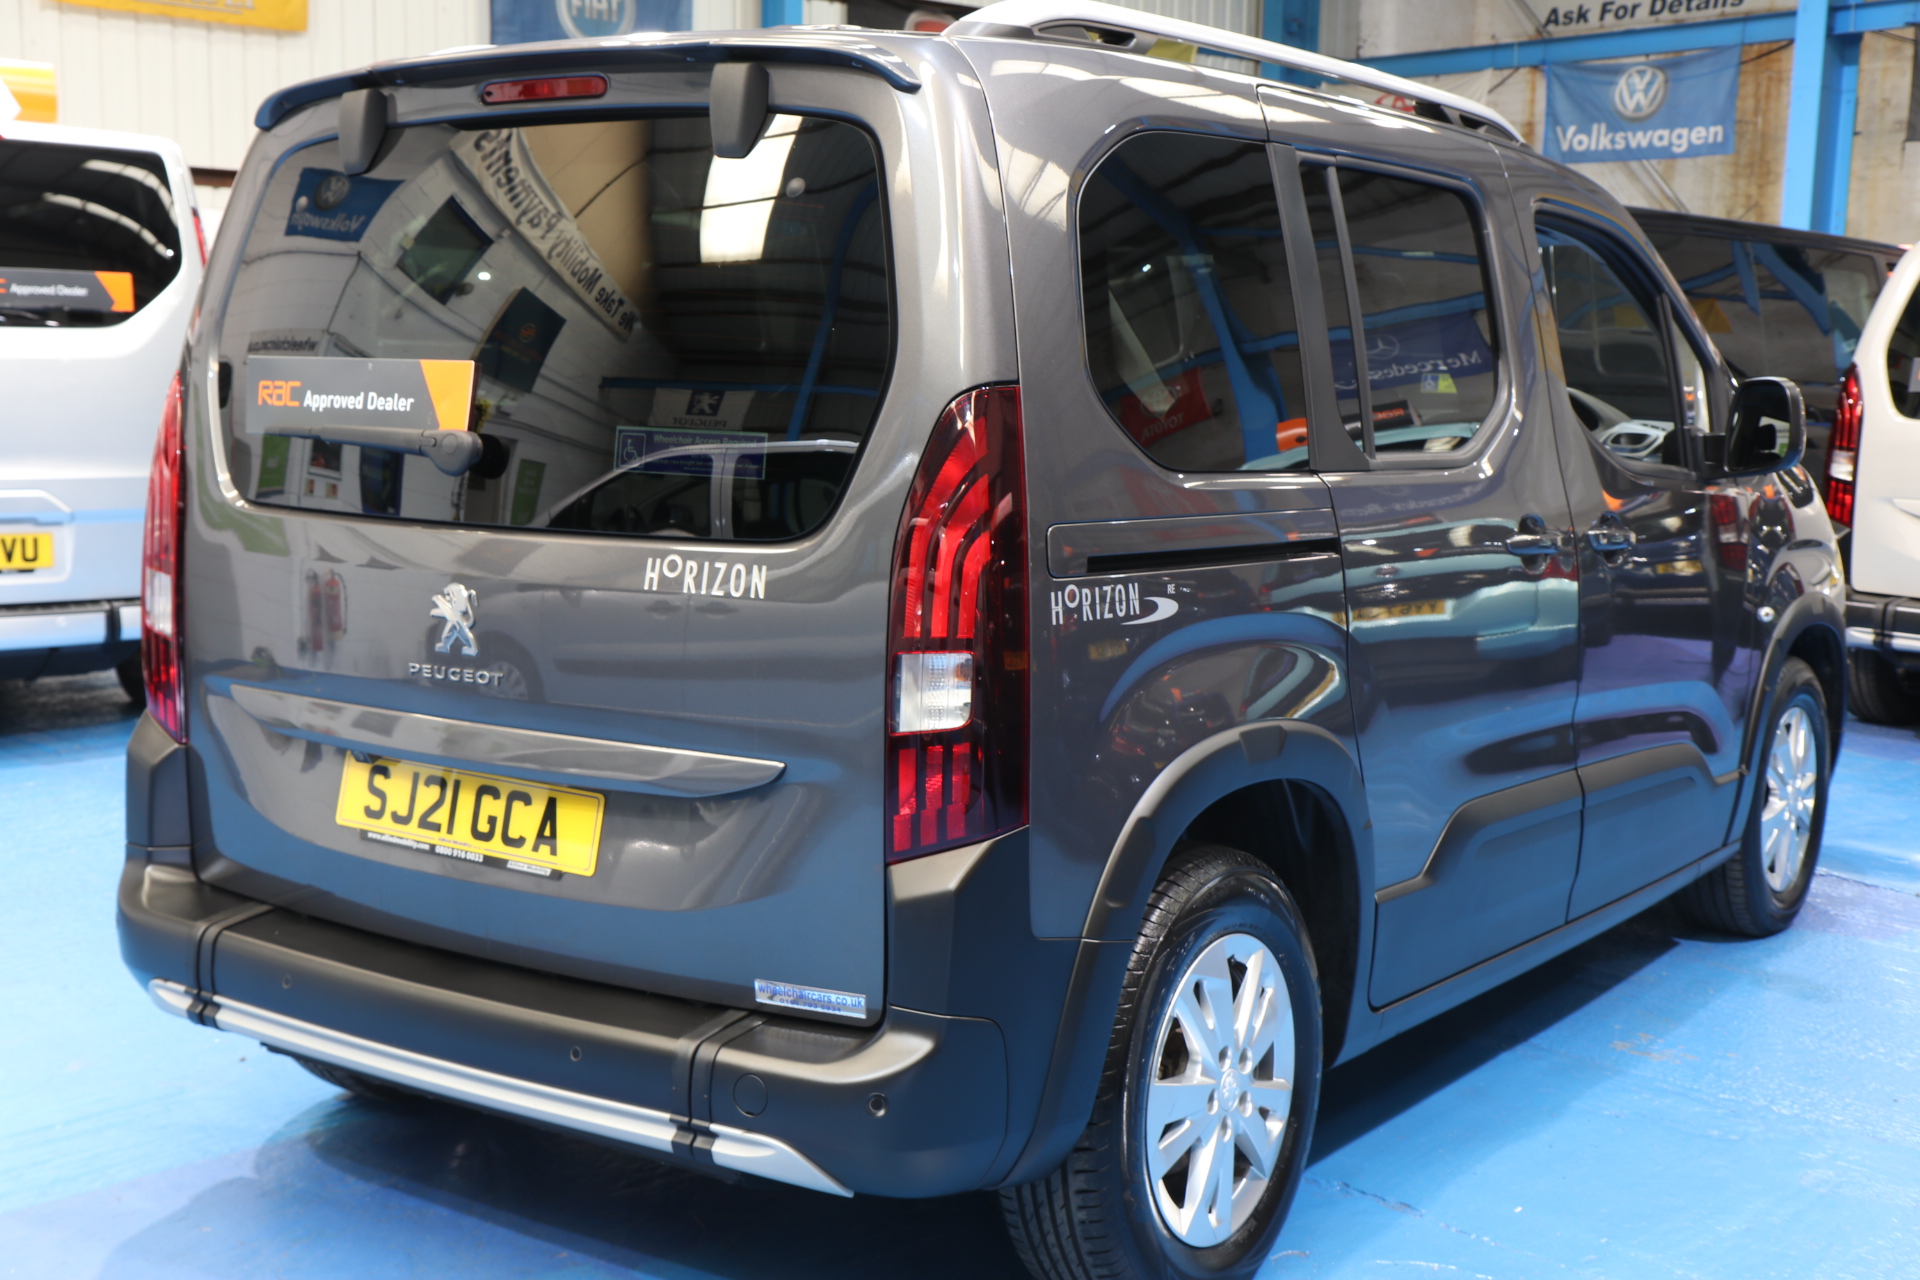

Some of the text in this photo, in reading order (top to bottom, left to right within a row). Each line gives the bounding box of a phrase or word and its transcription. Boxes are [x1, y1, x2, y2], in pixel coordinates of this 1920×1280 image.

[1543, 0, 1744, 29] Ask For Details
[1556, 122, 1724, 154] Volkswagen
[9, 282, 56, 297] Approved
[303, 389, 364, 412] Approved
[366, 391, 415, 412] Dealer
[653, 433, 693, 446] Wheelchair
[643, 553, 768, 600] HORIZON
[1166, 583, 1176, 595] RE
[1050, 582, 1140, 625] HORIZON
[408, 662, 504, 687] PEUGEOT
[363, 763, 559, 858] SJ21 GCA
[758, 983, 865, 1009] wheelchaircars.co.uk
